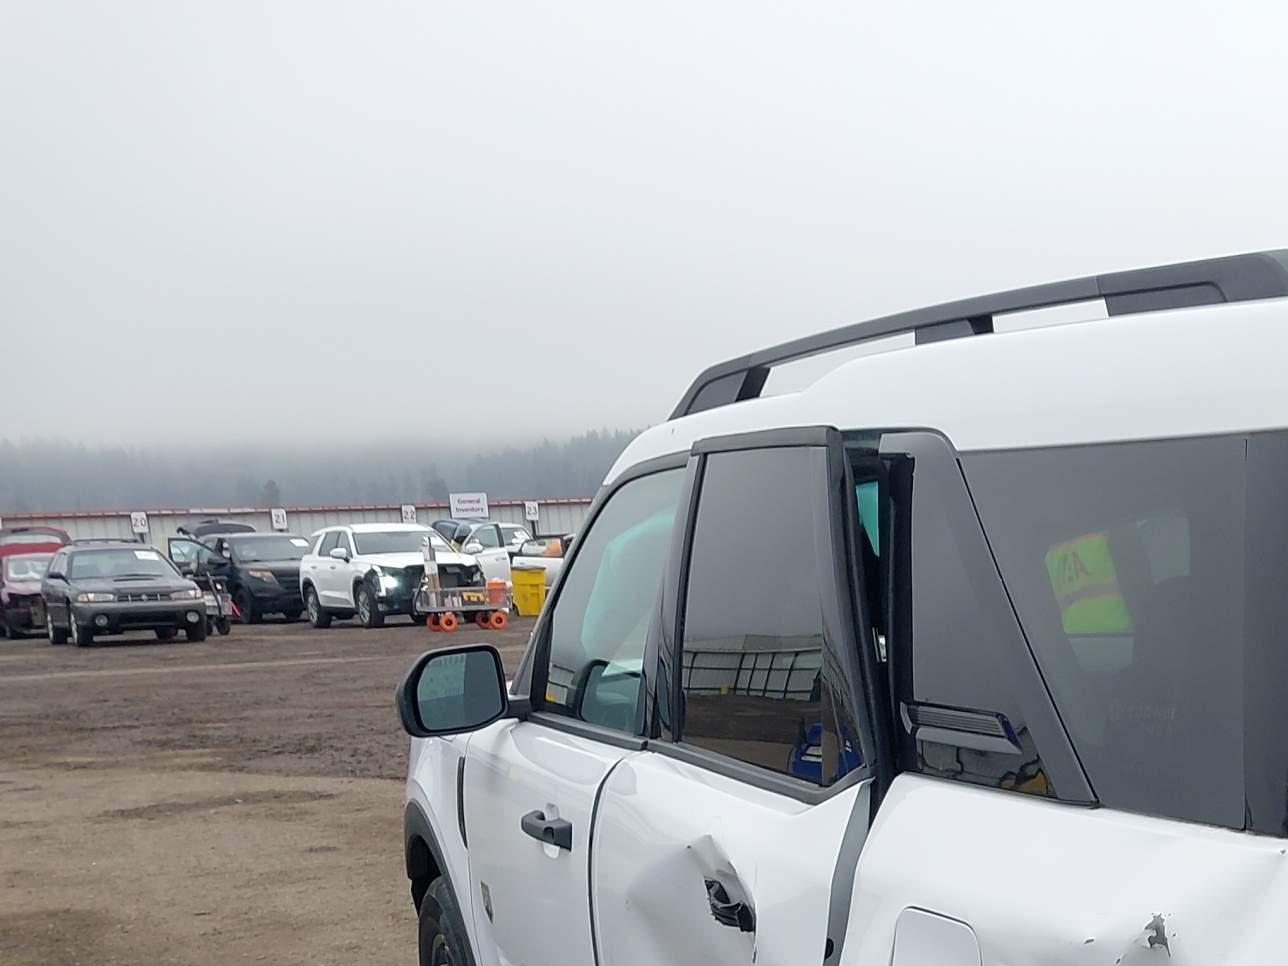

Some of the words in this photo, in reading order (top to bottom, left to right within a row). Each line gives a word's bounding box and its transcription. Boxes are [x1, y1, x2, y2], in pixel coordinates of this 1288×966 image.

[274, 514, 285, 524] 21
[403, 510, 416, 520] 22
[133, 518, 147, 528] 20
